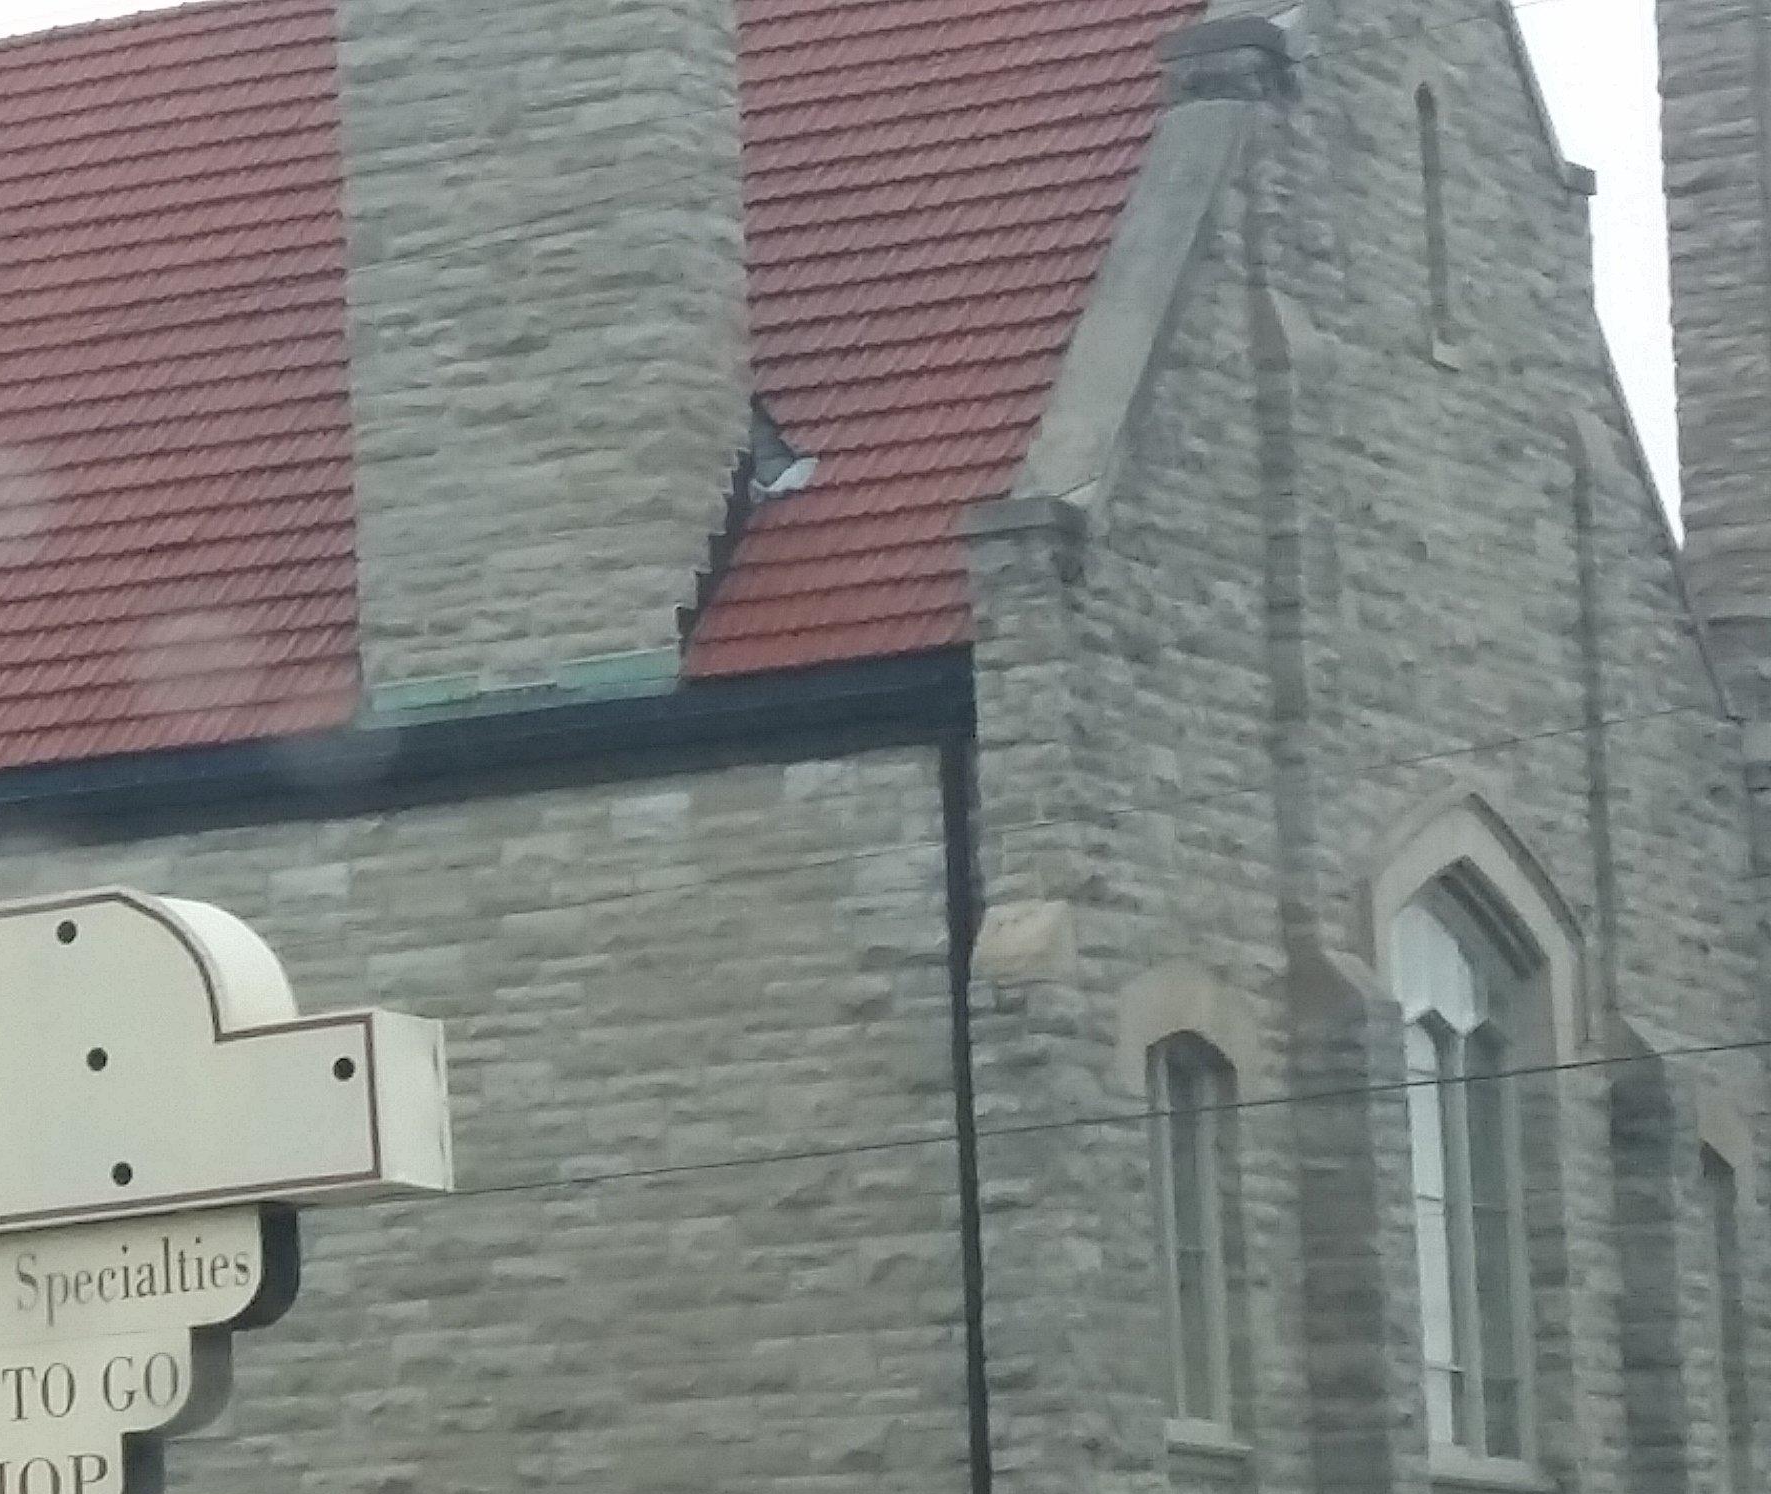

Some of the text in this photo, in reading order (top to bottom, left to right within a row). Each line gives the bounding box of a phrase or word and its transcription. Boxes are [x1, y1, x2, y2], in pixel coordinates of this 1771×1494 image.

[16, 1236, 252, 1327] Specialties
[2, 1362, 76, 1422] TO
[102, 1352, 180, 1413] GO
